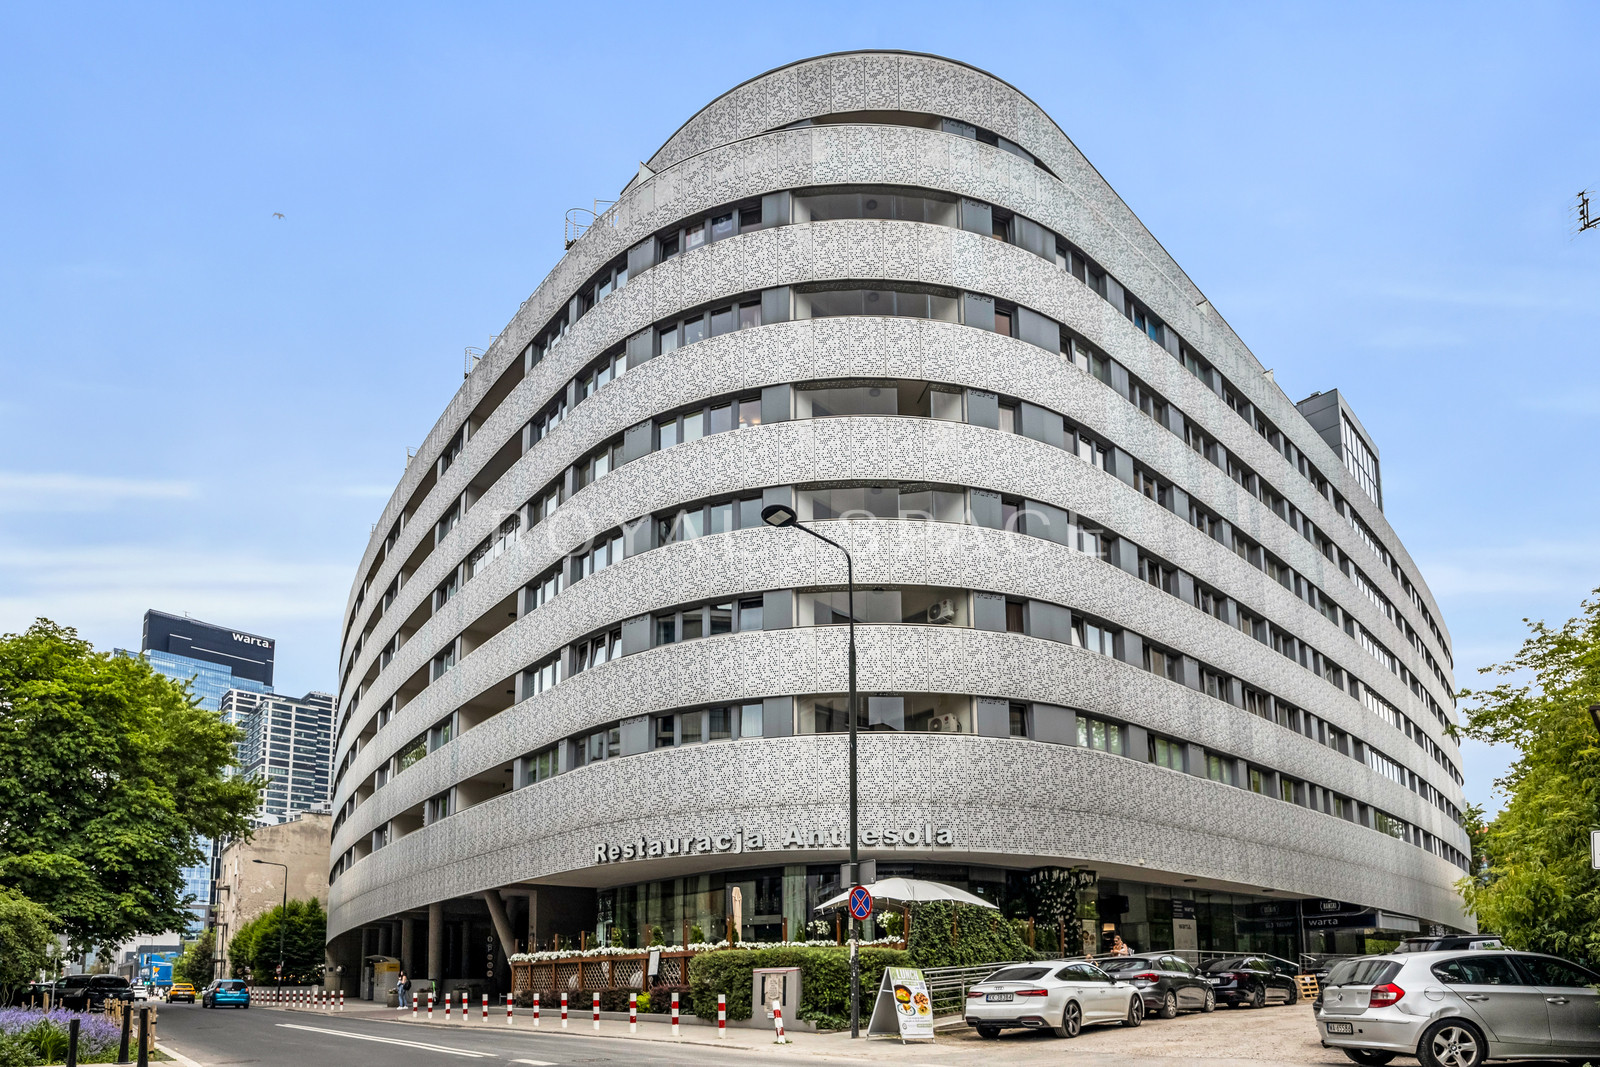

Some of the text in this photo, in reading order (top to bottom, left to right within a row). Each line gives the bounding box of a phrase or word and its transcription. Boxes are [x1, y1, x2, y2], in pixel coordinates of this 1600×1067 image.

[594, 827, 765, 863] Restauracja
[1308, 918, 1339, 927] warta
[896, 968, 919, 981] LUNCH
